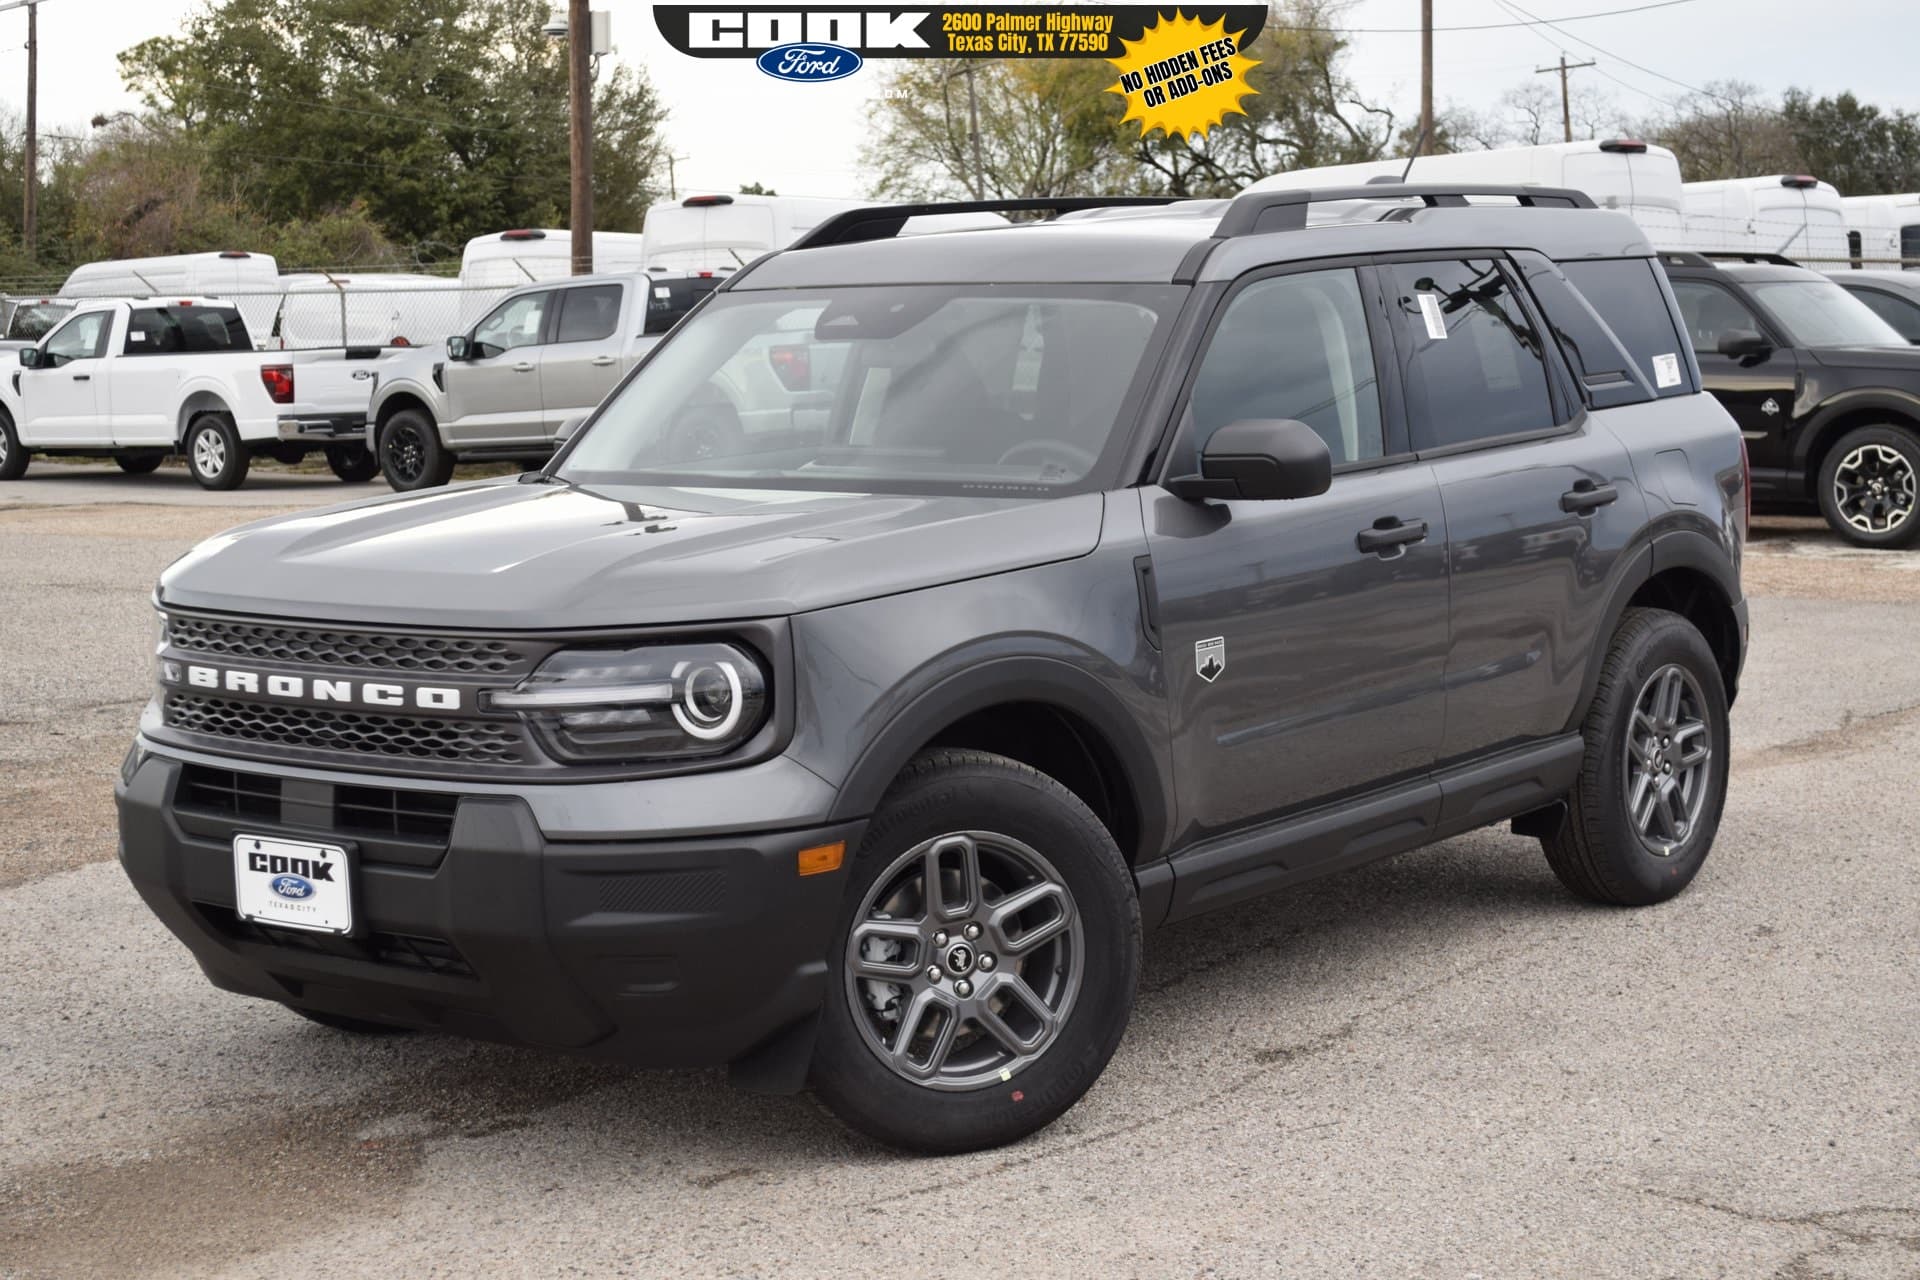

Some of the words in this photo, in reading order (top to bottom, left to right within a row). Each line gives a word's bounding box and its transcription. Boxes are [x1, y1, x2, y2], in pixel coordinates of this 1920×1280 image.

[187, 665, 461, 710] BRONCO
[248, 852, 335, 882] COOK
[278, 877, 306, 897] Ford
